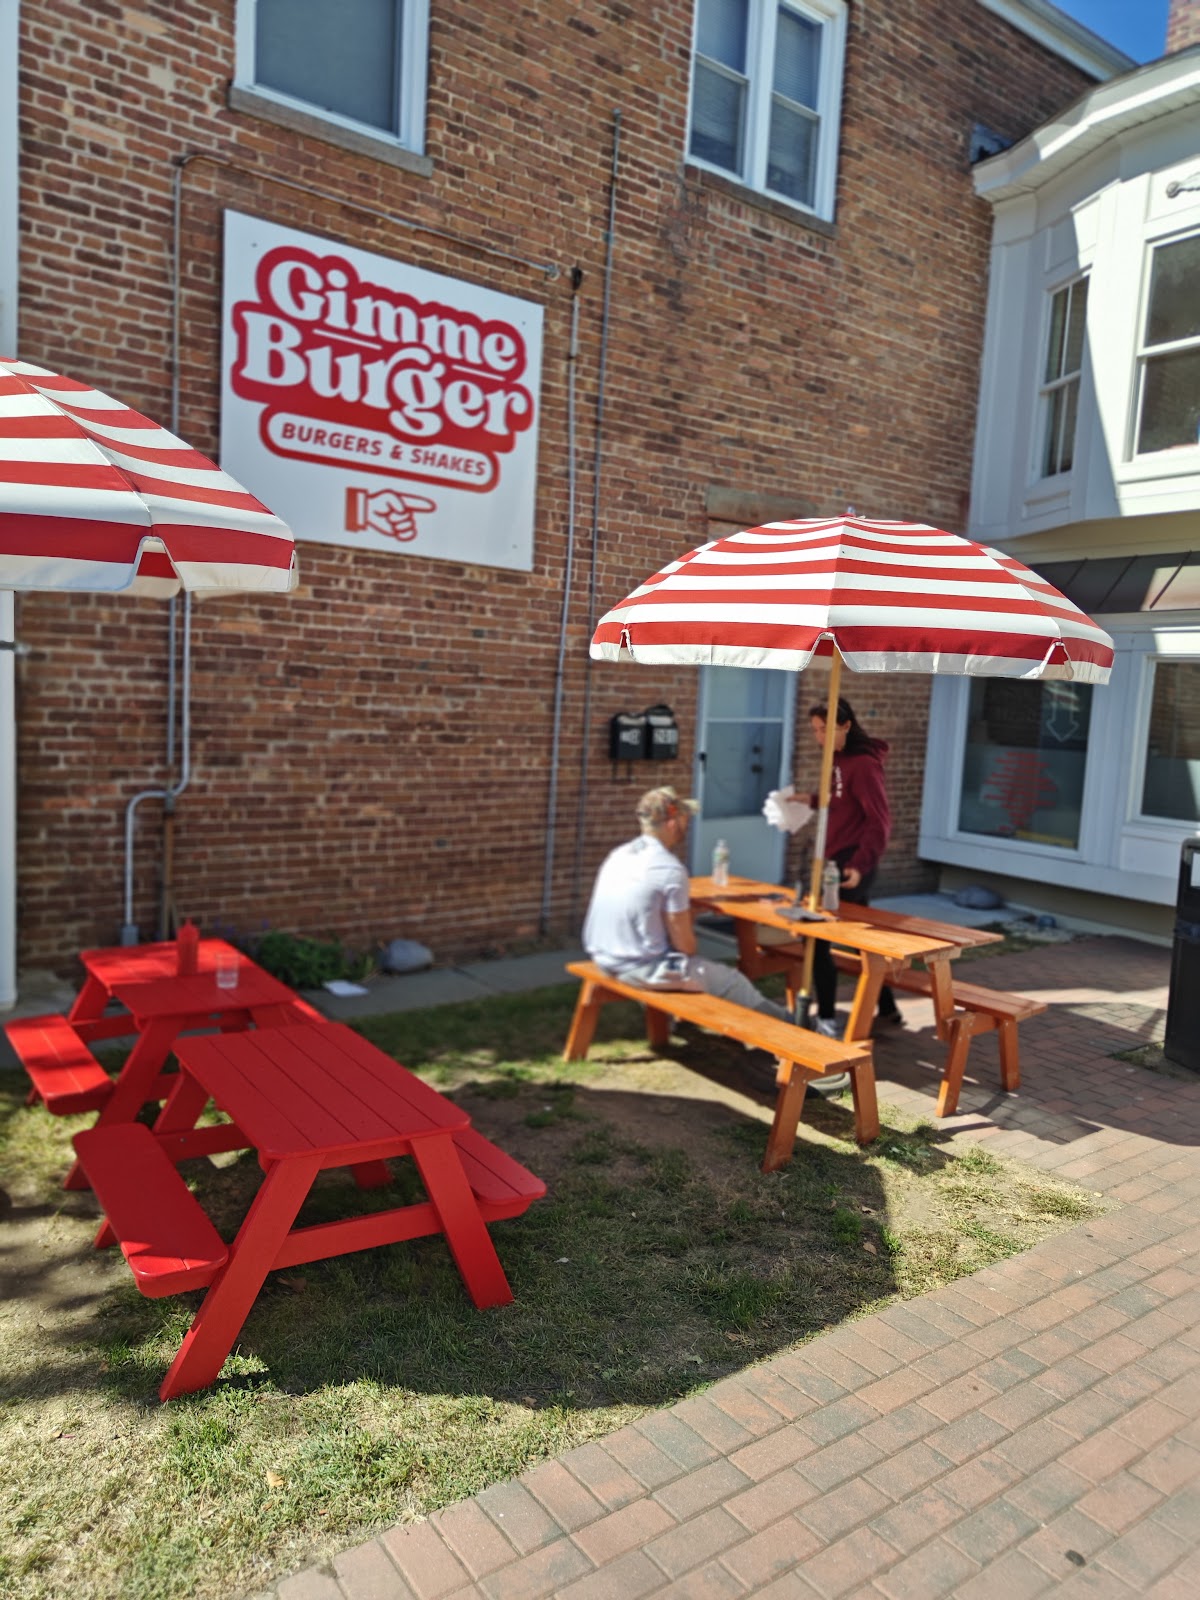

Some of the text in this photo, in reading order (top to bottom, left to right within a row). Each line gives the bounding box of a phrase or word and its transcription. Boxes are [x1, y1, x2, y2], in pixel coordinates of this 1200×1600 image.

[268, 259, 518, 372] Gimme
[239, 310, 529, 437] Burger
[281, 422, 486, 477] BURGERS & SHAKES
